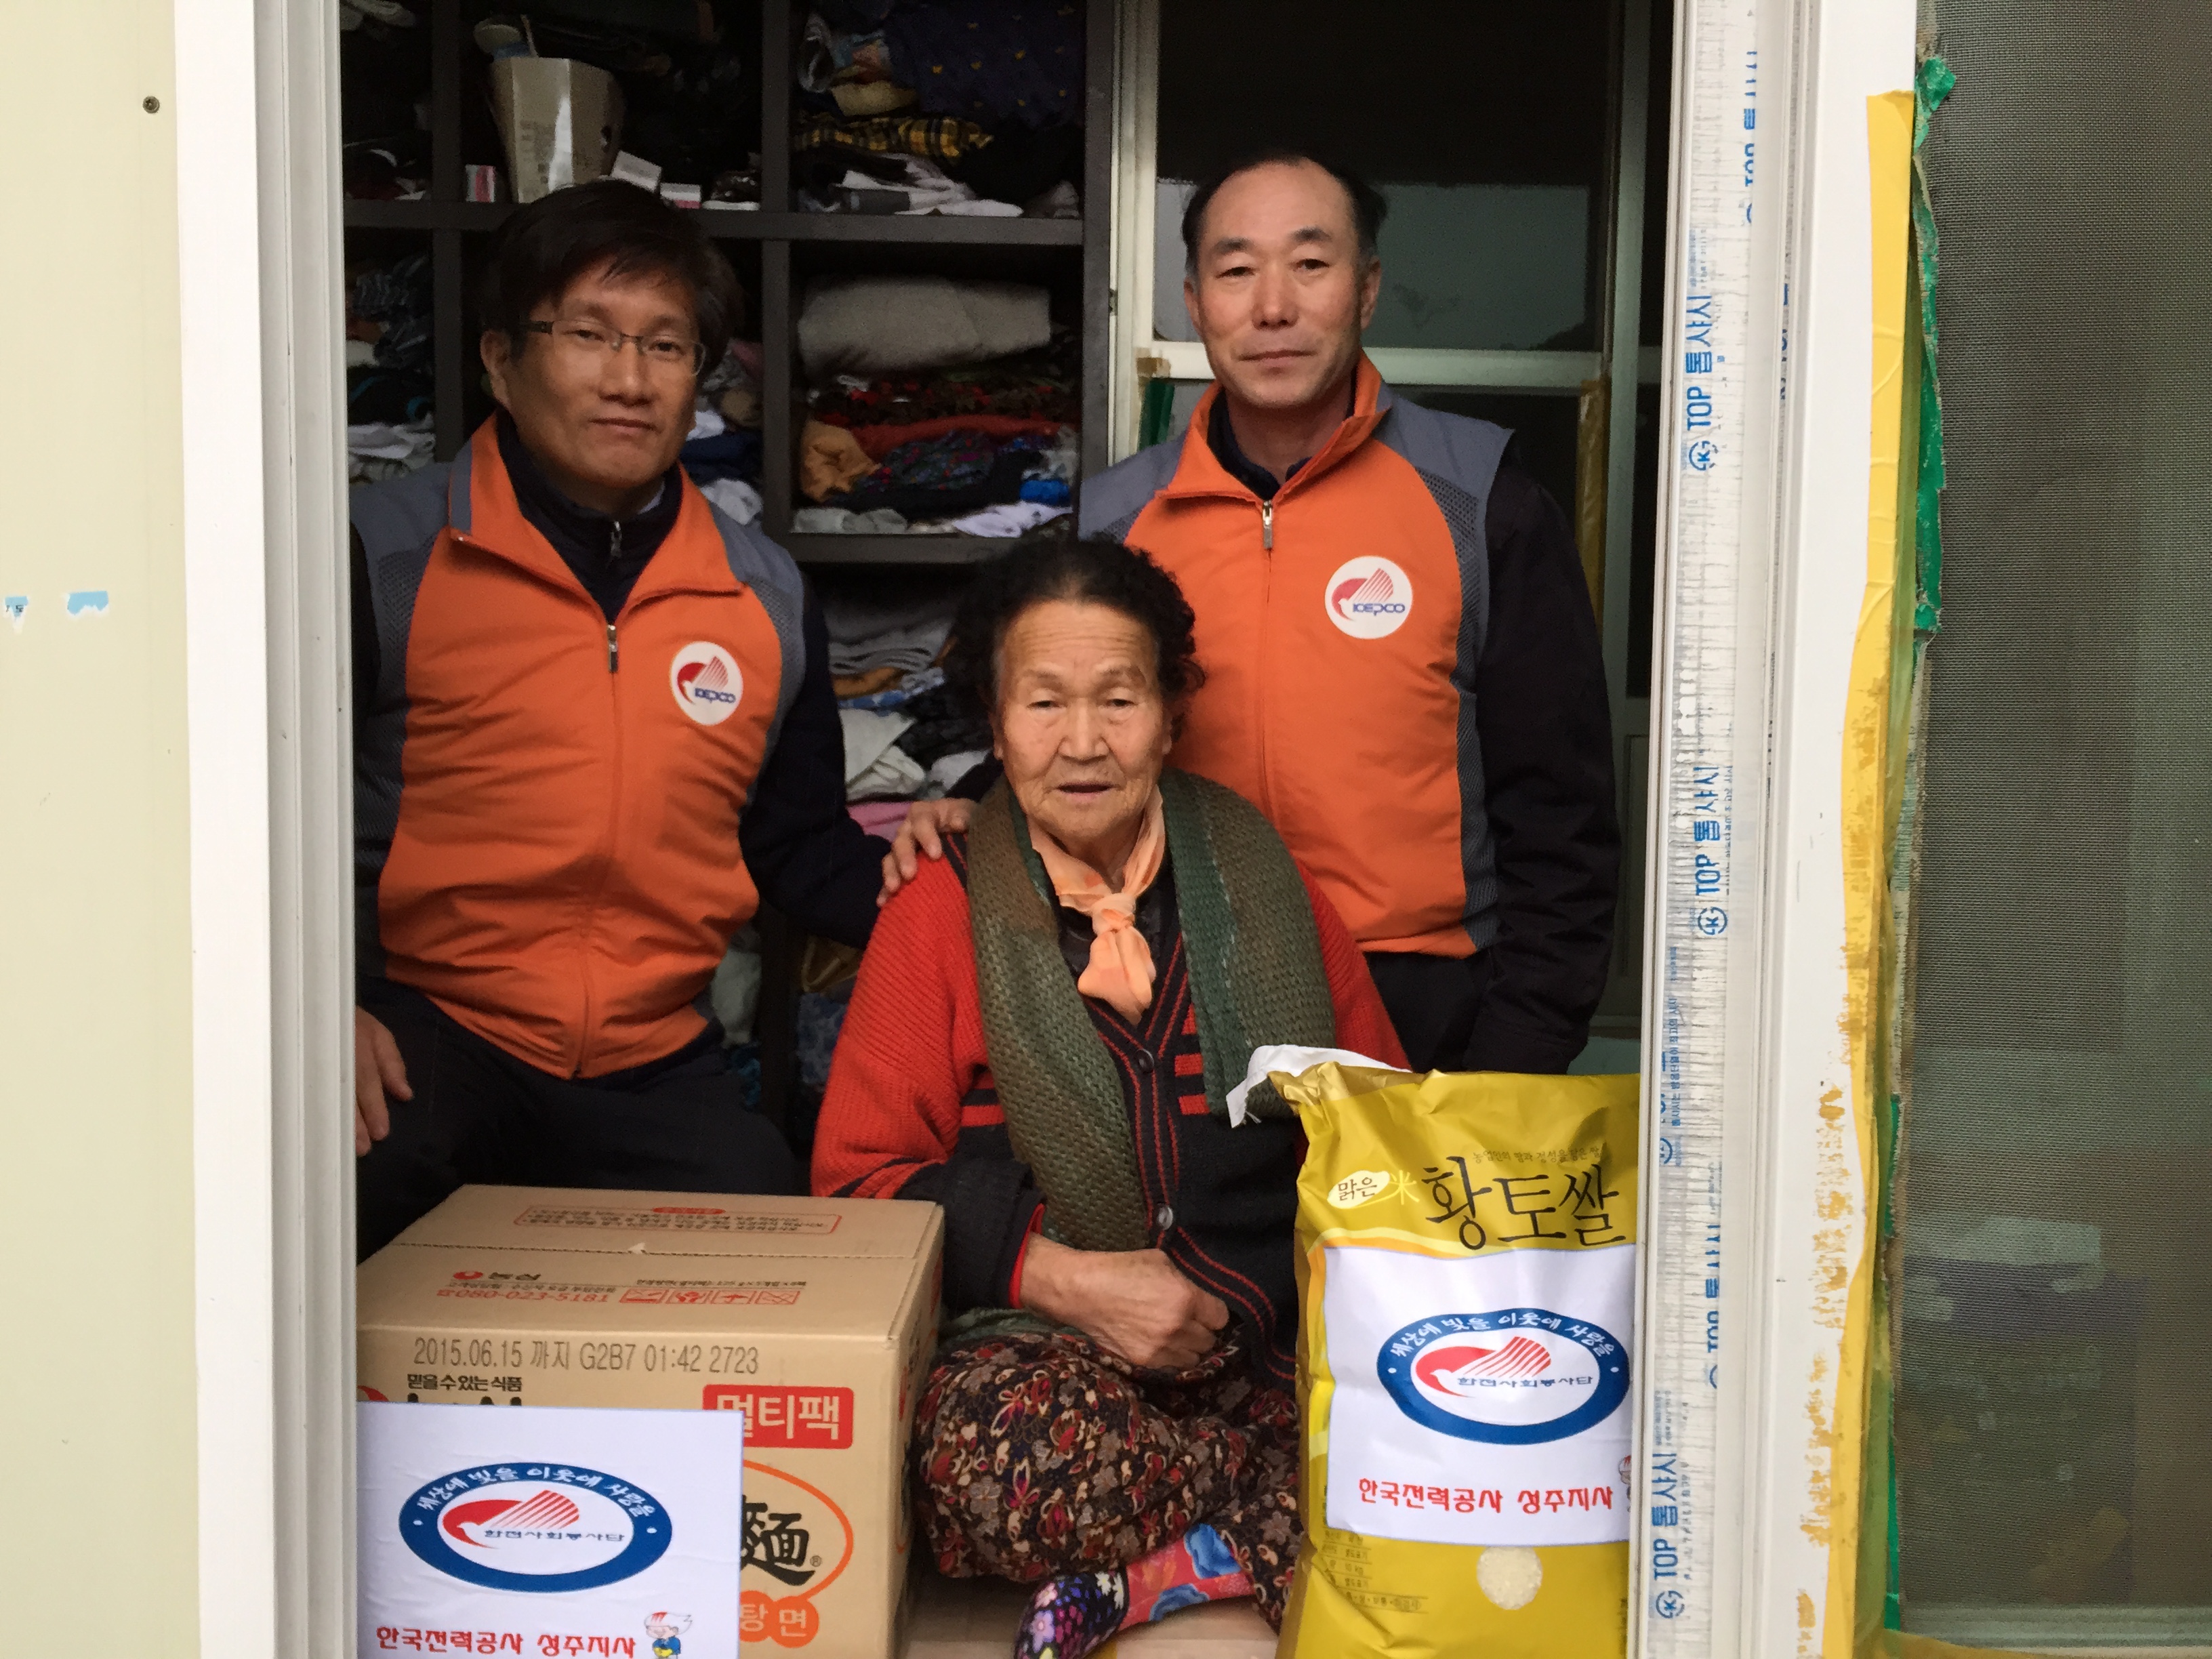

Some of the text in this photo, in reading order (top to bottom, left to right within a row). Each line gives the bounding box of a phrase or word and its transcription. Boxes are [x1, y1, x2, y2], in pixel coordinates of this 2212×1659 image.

[1686, 386, 1713, 431] TOP
[1695, 854, 1720, 896] TOP
[1338, 1176, 1377, 1201] 맑은
[1421, 1155, 1626, 1250] 황토쌀
[1391, 1311, 1616, 1357] 세상에 빛을 이웃에 사랑을
[413, 1337, 759, 1375] 2015.06.15 까지 G2B7 01:42 2723
[407, 1373, 438, 1390] 믿을
[491, 1376, 523, 1393] 식품
[1457, 1376, 1593, 1388] 한전사회봉사단
[416, 1466, 656, 1519] 세상에 빛을 이웃에 사랑을
[1358, 1477, 1614, 1515] 한국전력공사 성주지사
[483, 1529, 626, 1542] 한전사회봉사단
[1653, 1538, 1677, 1580] TOP
[376, 1625, 636, 1659] 한국전력공사 성주지사
